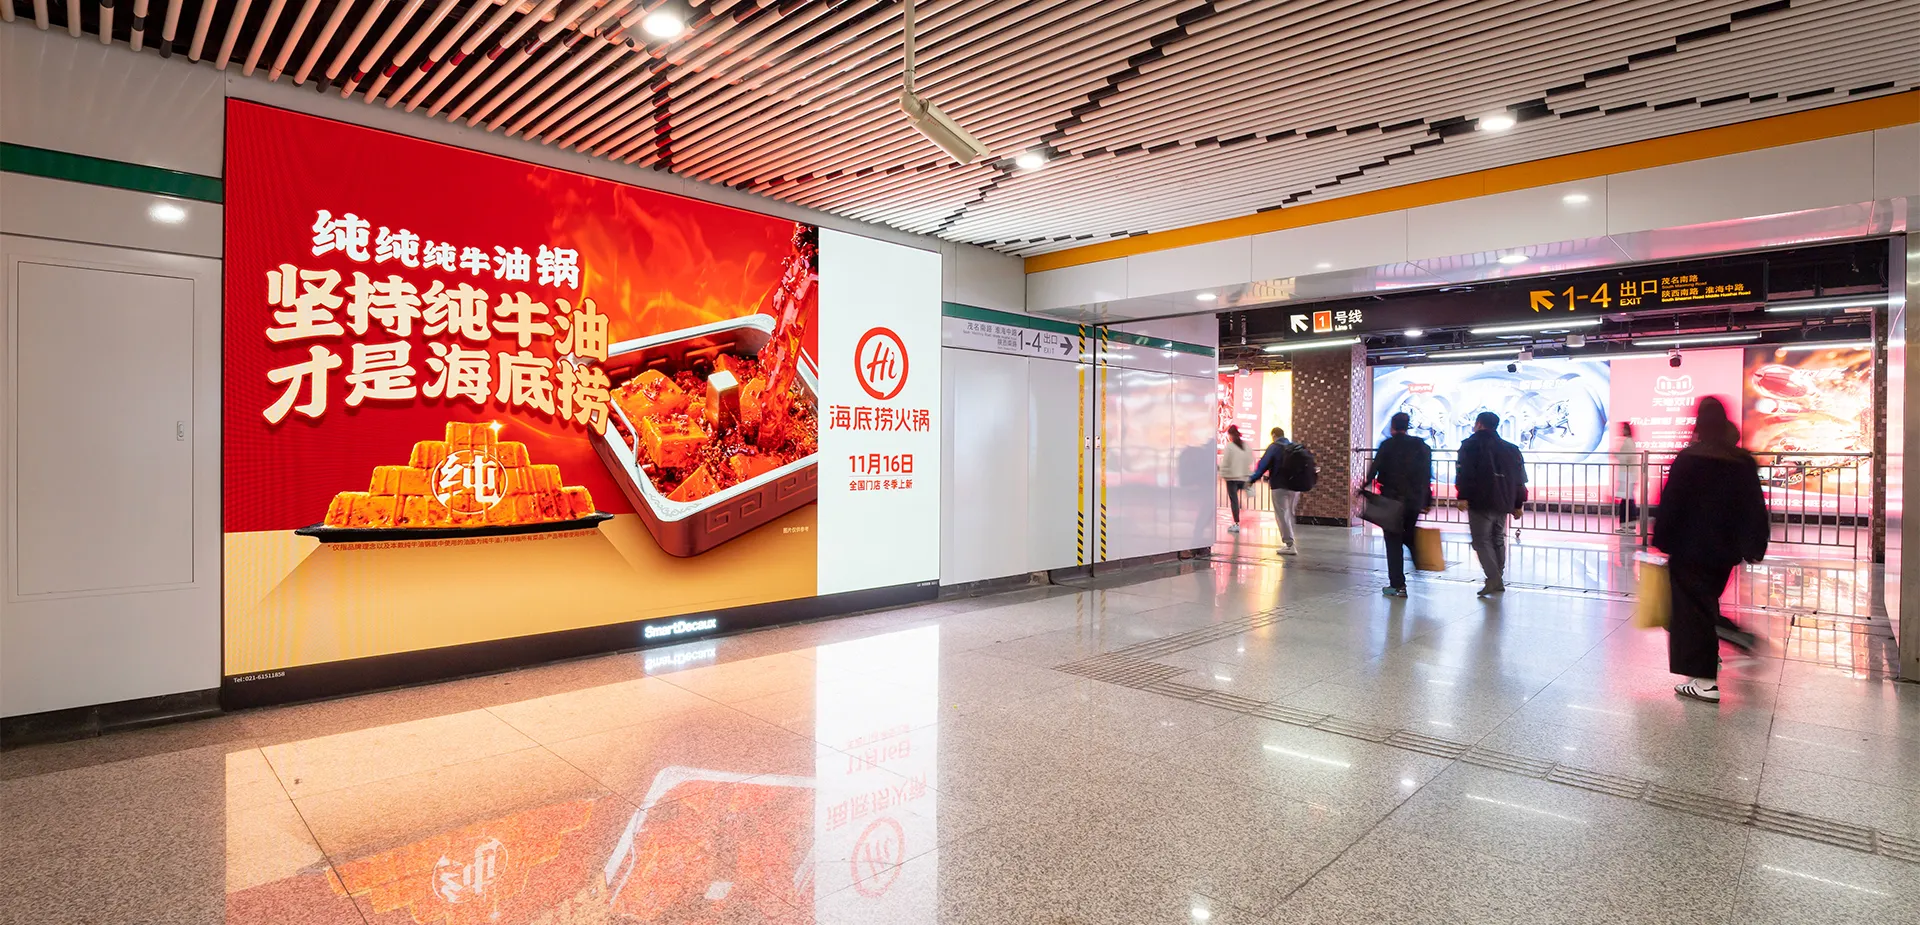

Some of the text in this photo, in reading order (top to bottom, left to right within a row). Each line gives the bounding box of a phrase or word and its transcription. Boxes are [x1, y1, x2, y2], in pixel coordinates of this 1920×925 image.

[311, 209, 580, 290] 纯纯纯牛油锅
[1620, 280, 1657, 297] 出口
[1661, 275, 1698, 285] 茂名南路
[1661, 283, 1744, 298] 陕西南路 淮海中路
[1562, 283, 1612, 311] 1-4
[1620, 297, 1641, 306] EXIT
[265, 263, 610, 361] 坚持纯牛油
[1319, 310, 1362, 328] 1 号线
[1018, 330, 1041, 352] 1-4
[1044, 333, 1057, 345] 出口
[867, 341, 897, 383] Hi
[262, 341, 612, 435] 才是海底捞
[830, 404, 929, 432] 海底捞火锅
[849, 453, 913, 474] 11月16日
[438, 453, 500, 504] 纯
[849, 479, 912, 491] 全国门店 冬季上新
[645, 619, 717, 638] SmartDecaux
